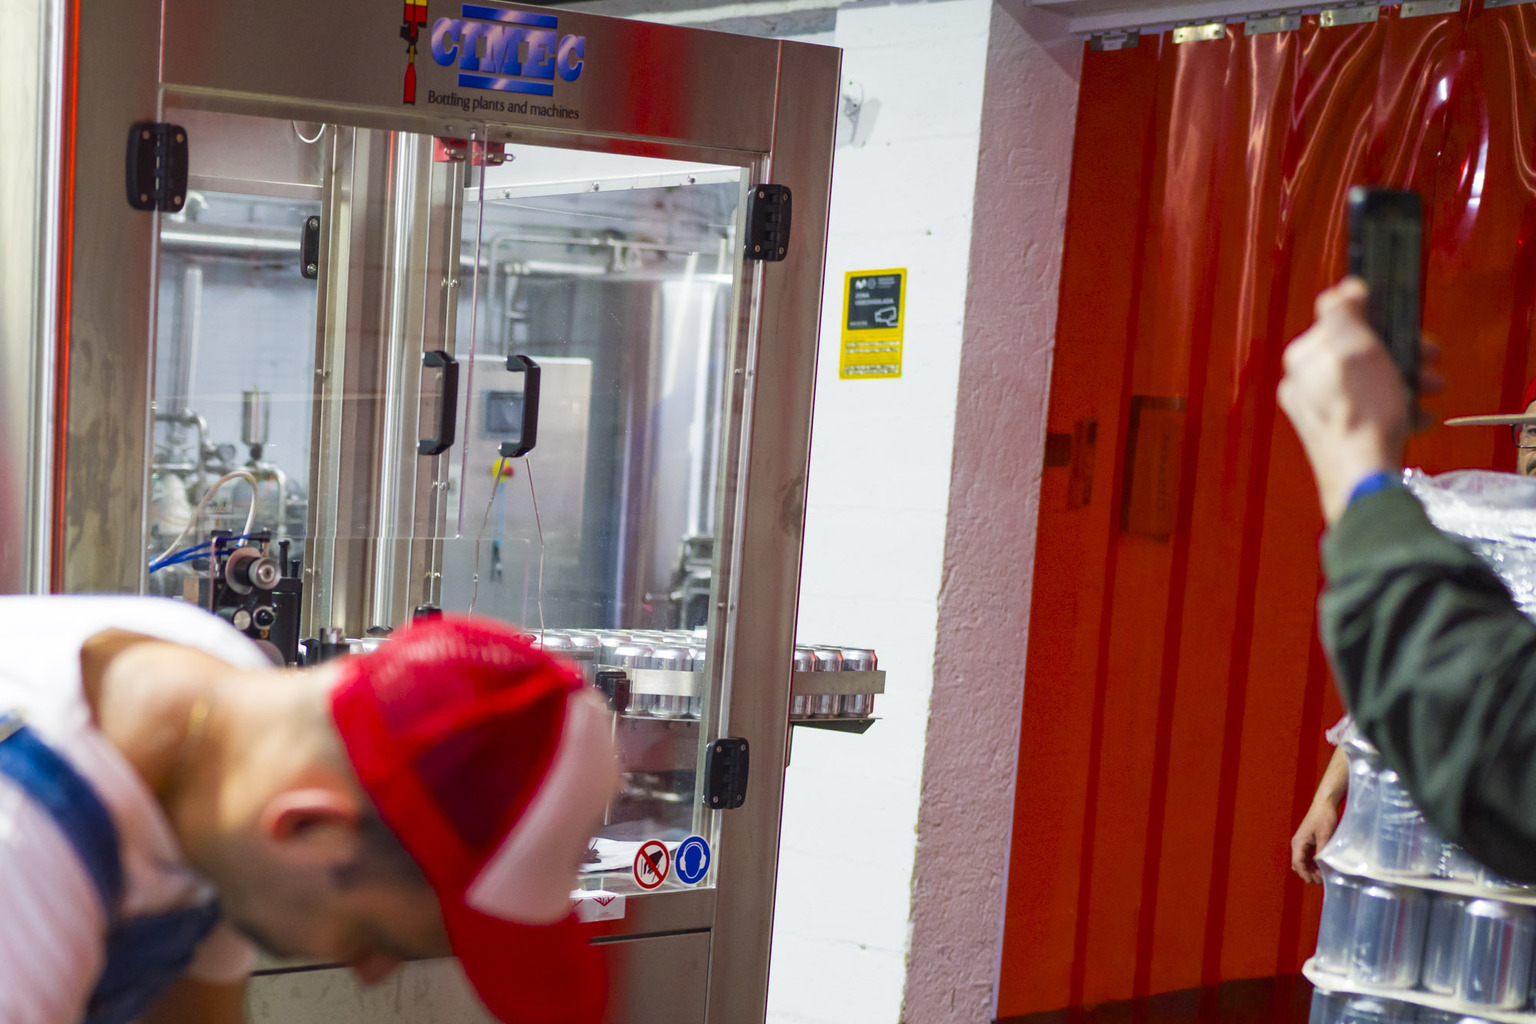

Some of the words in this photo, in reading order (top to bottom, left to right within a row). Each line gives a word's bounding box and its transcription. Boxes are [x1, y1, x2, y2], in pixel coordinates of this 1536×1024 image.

[431, 17, 586, 82] CIMEC
[428, 89, 470, 112] Bottling
[472, 96, 505, 113] plants
[507, 101, 528, 114] and
[530, 103, 580, 120] machines
